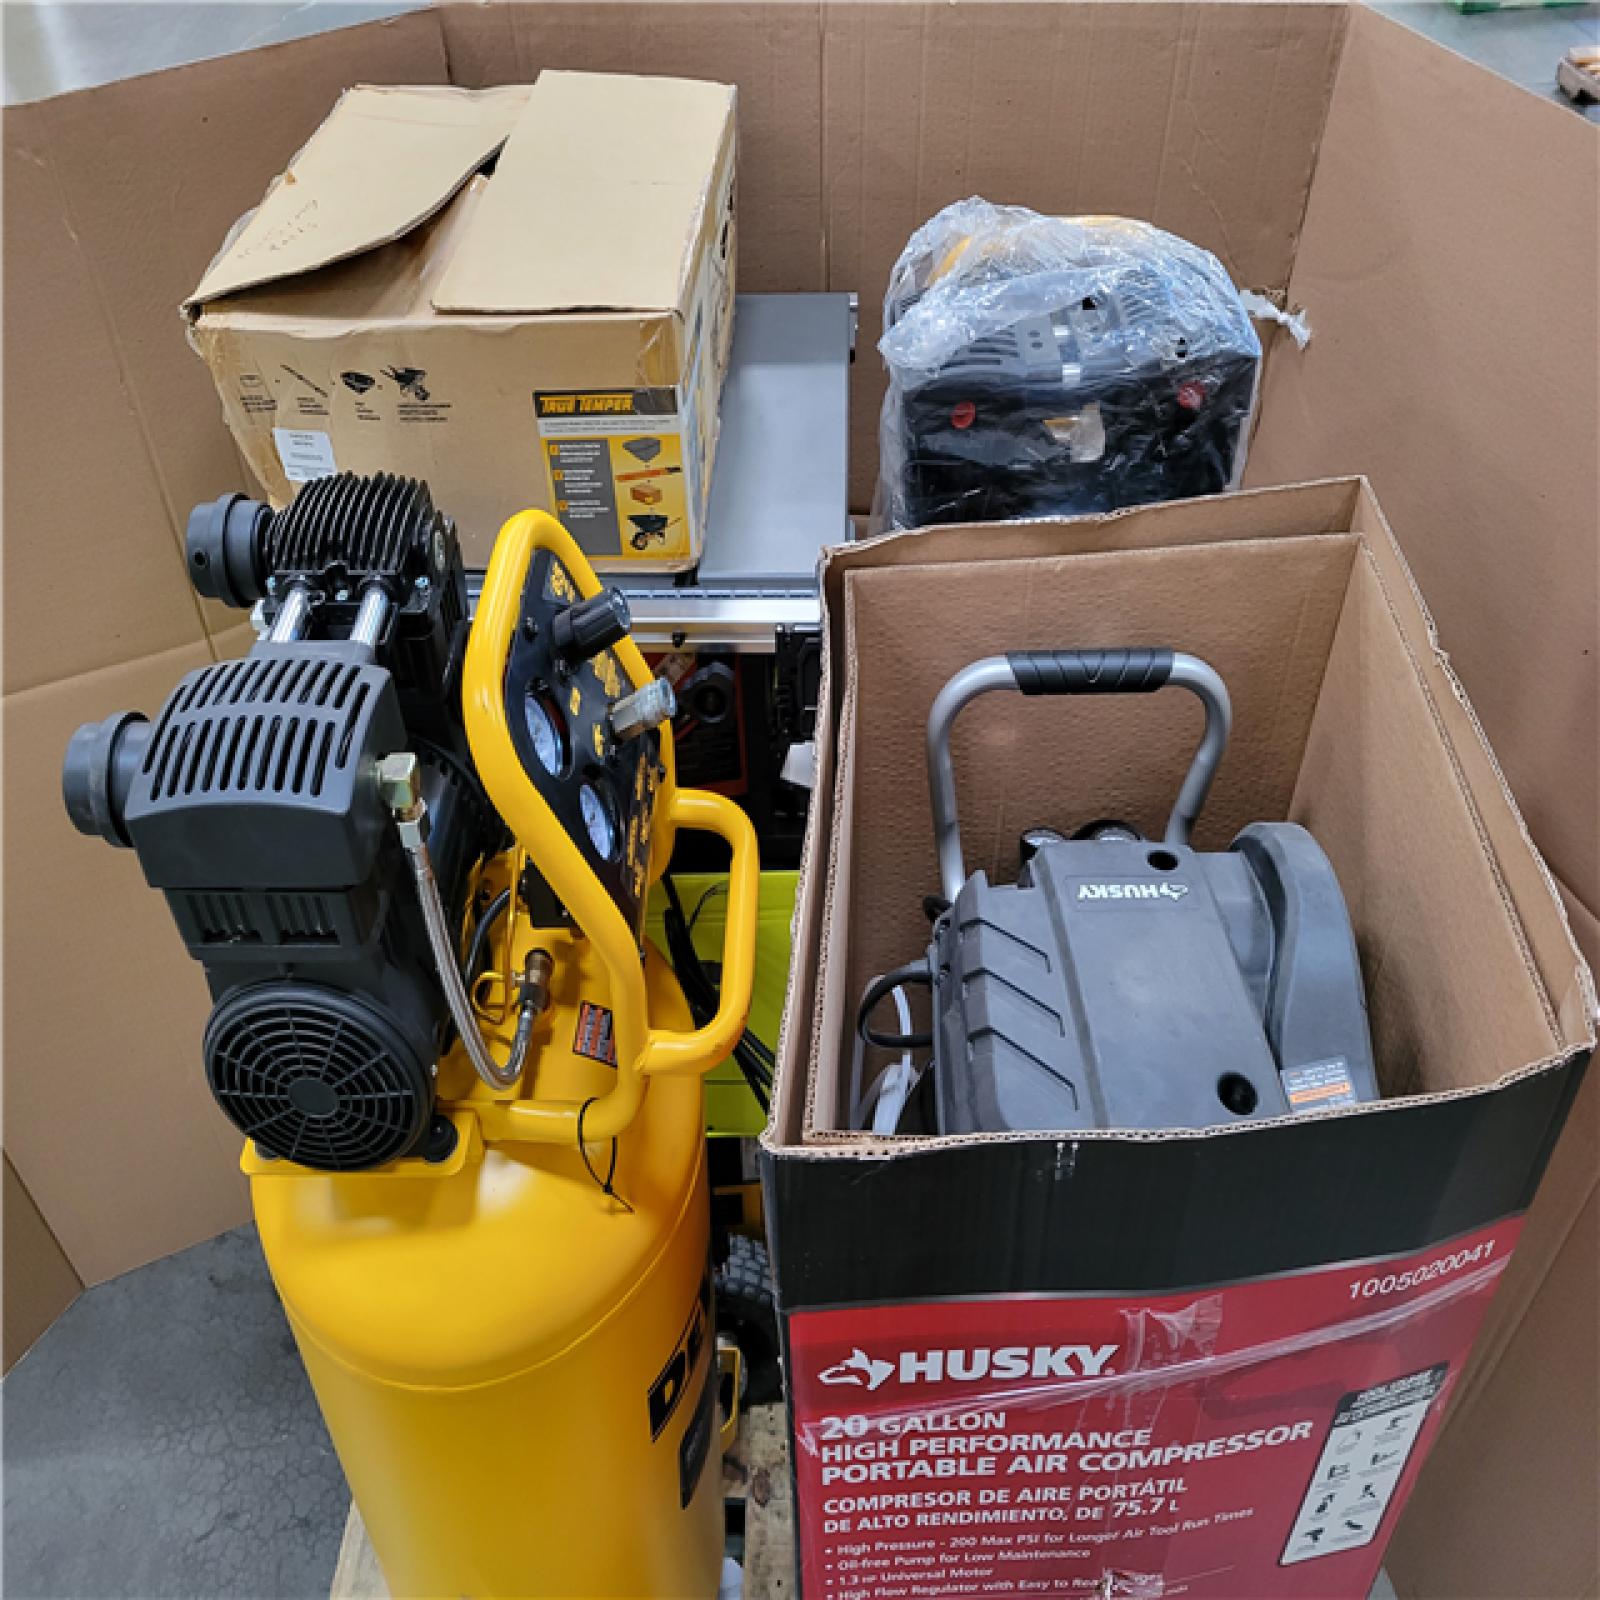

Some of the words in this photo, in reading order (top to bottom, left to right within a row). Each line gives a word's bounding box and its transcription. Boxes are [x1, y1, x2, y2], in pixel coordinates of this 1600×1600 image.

[1078, 884, 1159, 901] HUSKY
[1350, 1239, 1496, 1299] 1005020041
[819, 1414, 868, 1440] 20
[878, 1411, 1007, 1434] GALLON
[820, 1456, 997, 1486] PORTABLE
[1006, 1454, 1069, 1474] AIR
[1078, 1420, 1314, 1472] COMPRESSOR
[821, 1439, 899, 1464] HIGH
[908, 1428, 1151, 1457] PERFORMANCE
[823, 1489, 971, 1515] COMPRESOR
[979, 1488, 1011, 1504] DE
[1015, 1486, 1073, 1503] AIRE
[1078, 1476, 1189, 1502] PORTÁTIL
[823, 1519, 851, 1534] DE
[857, 1513, 910, 1531] ALTO
[1075, 1506, 1105, 1521] DE
[1111, 1497, 1166, 1519] 75.7
[837, 1543, 871, 1556] High
[874, 1540, 936, 1552] Pressure
[949, 1536, 978, 1549] 200
[980, 1534, 1012, 1546] Max
[1016, 1533, 1041, 1545] PSI
[1044, 1532, 1066, 1544] for
[1069, 1530, 1119, 1544] Longer
[1122, 1528, 1146, 1540] Air
[1149, 1522, 1179, 1536] Tool
[1182, 1517, 1211, 1531] Run
[1214, 1507, 1255, 1523] Times
[880, 1569, 946, 1583] Universal
[949, 1567, 994, 1578] Motor
[894, 1555, 935, 1567] Pump
[939, 1553, 961, 1564] for
[964, 1551, 995, 1562] Low
[998, 1549, 1091, 1562] Maintenance
[839, 1588, 871, 1600] High
[874, 1585, 907, 1597] Flow
[911, 1583, 979, 1597] Regulator
[982, 1579, 1014, 1591] with
[1018, 1579, 1050, 1592] Easy
[1054, 1579, 1068, 1589] to
